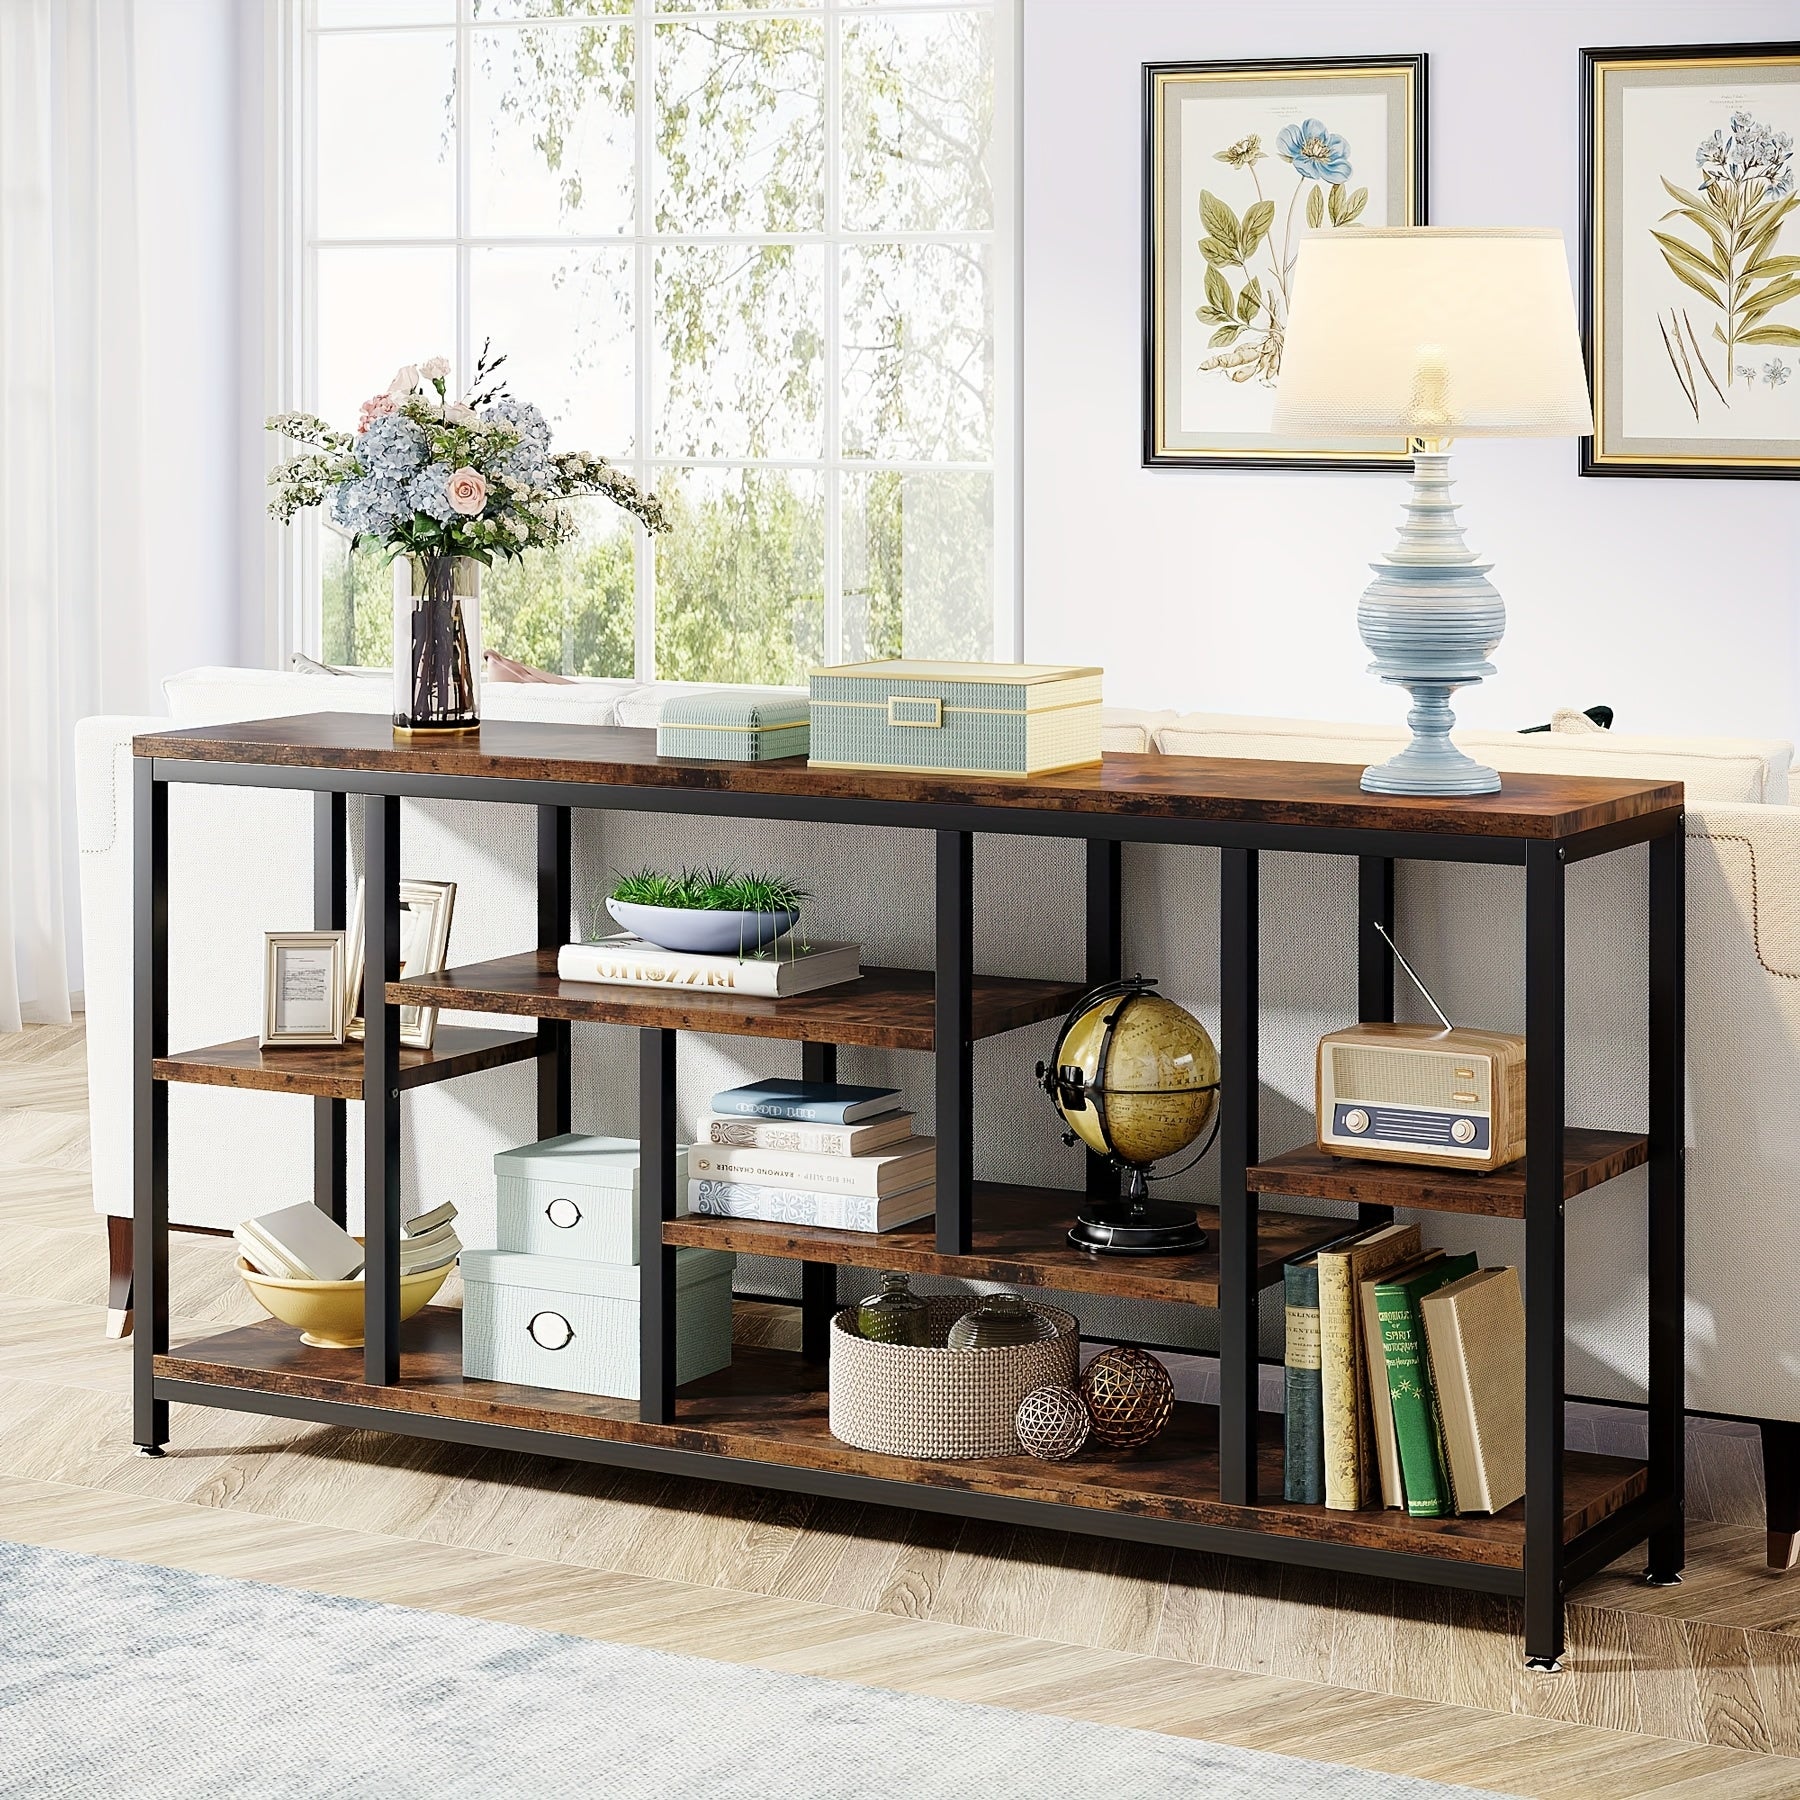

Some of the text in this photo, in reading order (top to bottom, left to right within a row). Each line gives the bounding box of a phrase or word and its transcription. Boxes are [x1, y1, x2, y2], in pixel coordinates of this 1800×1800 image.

[716, 1163, 754, 1174] CHANDLER
[756, 1168, 794, 1178] RAYMOND
[1385, 1330, 1412, 1341] SPIRIT
